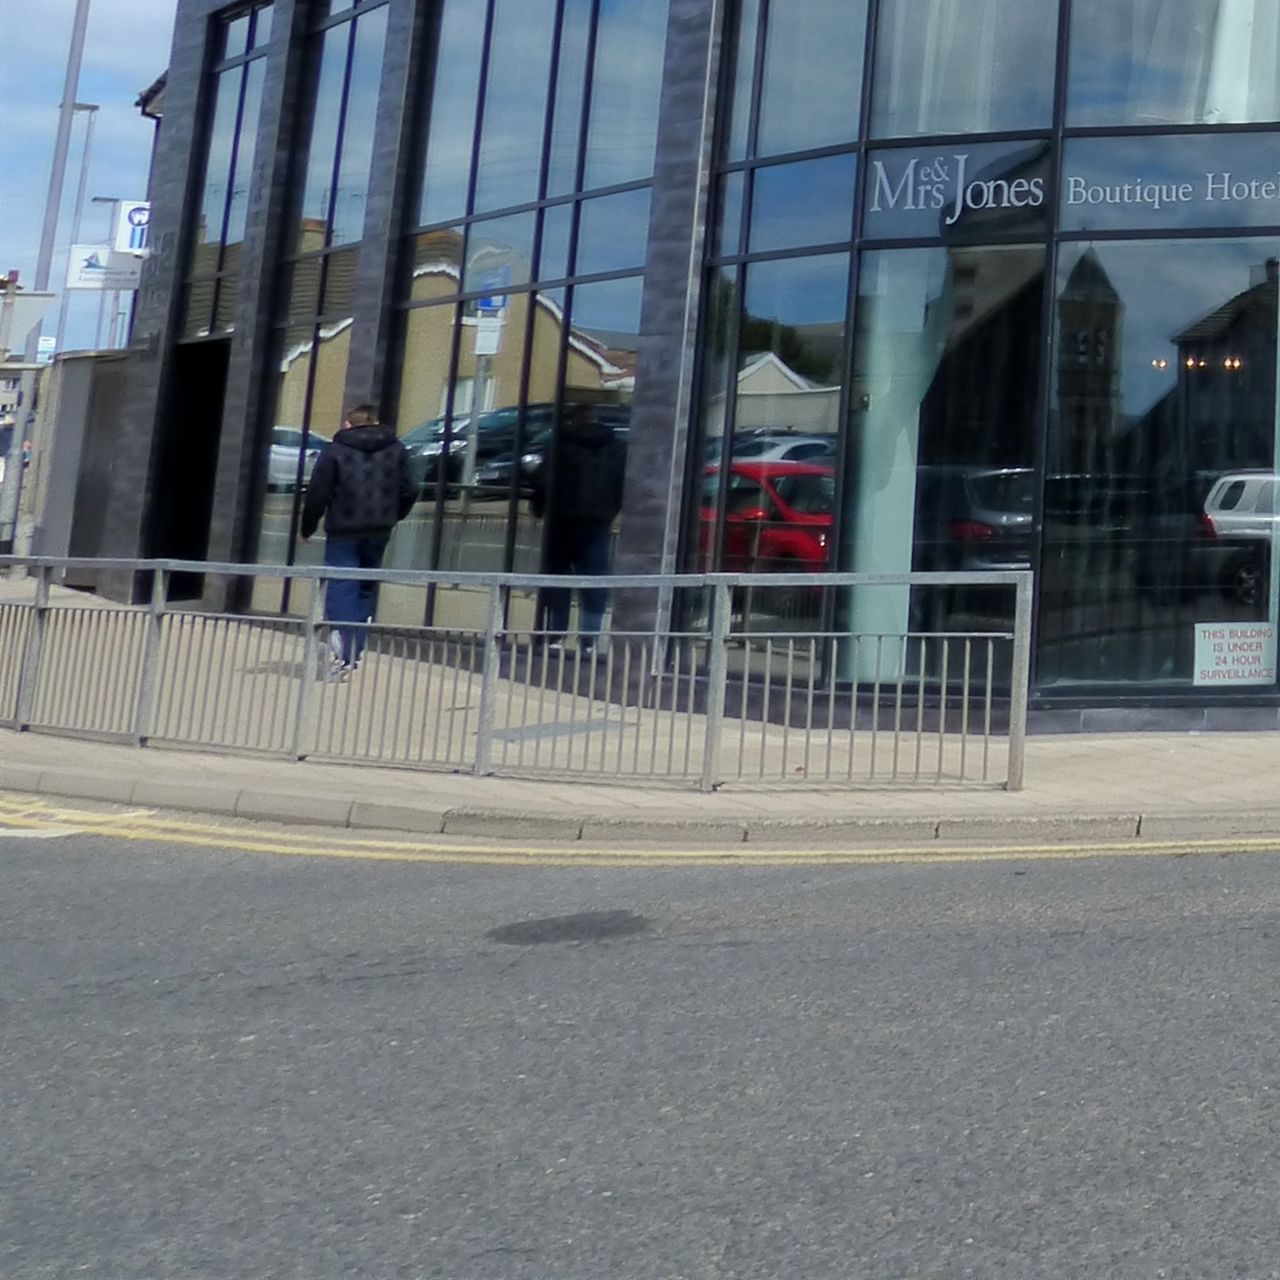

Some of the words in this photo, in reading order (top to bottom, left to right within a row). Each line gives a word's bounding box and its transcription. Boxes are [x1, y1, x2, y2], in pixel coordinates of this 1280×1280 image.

[945, 153, 1044, 225] Jones
[1066, 176, 1193, 209] Boutique
[1202, 629, 1225, 640] THIS
[1229, 627, 1273, 640] BUILDING
[1213, 643, 1224, 653] IS
[1228, 642, 1262, 653] UNDER
[1215, 656, 1228, 666] 24
[1232, 656, 1261, 666] HOUR
[1200, 668, 1274, 680] SURVEILLANCE
